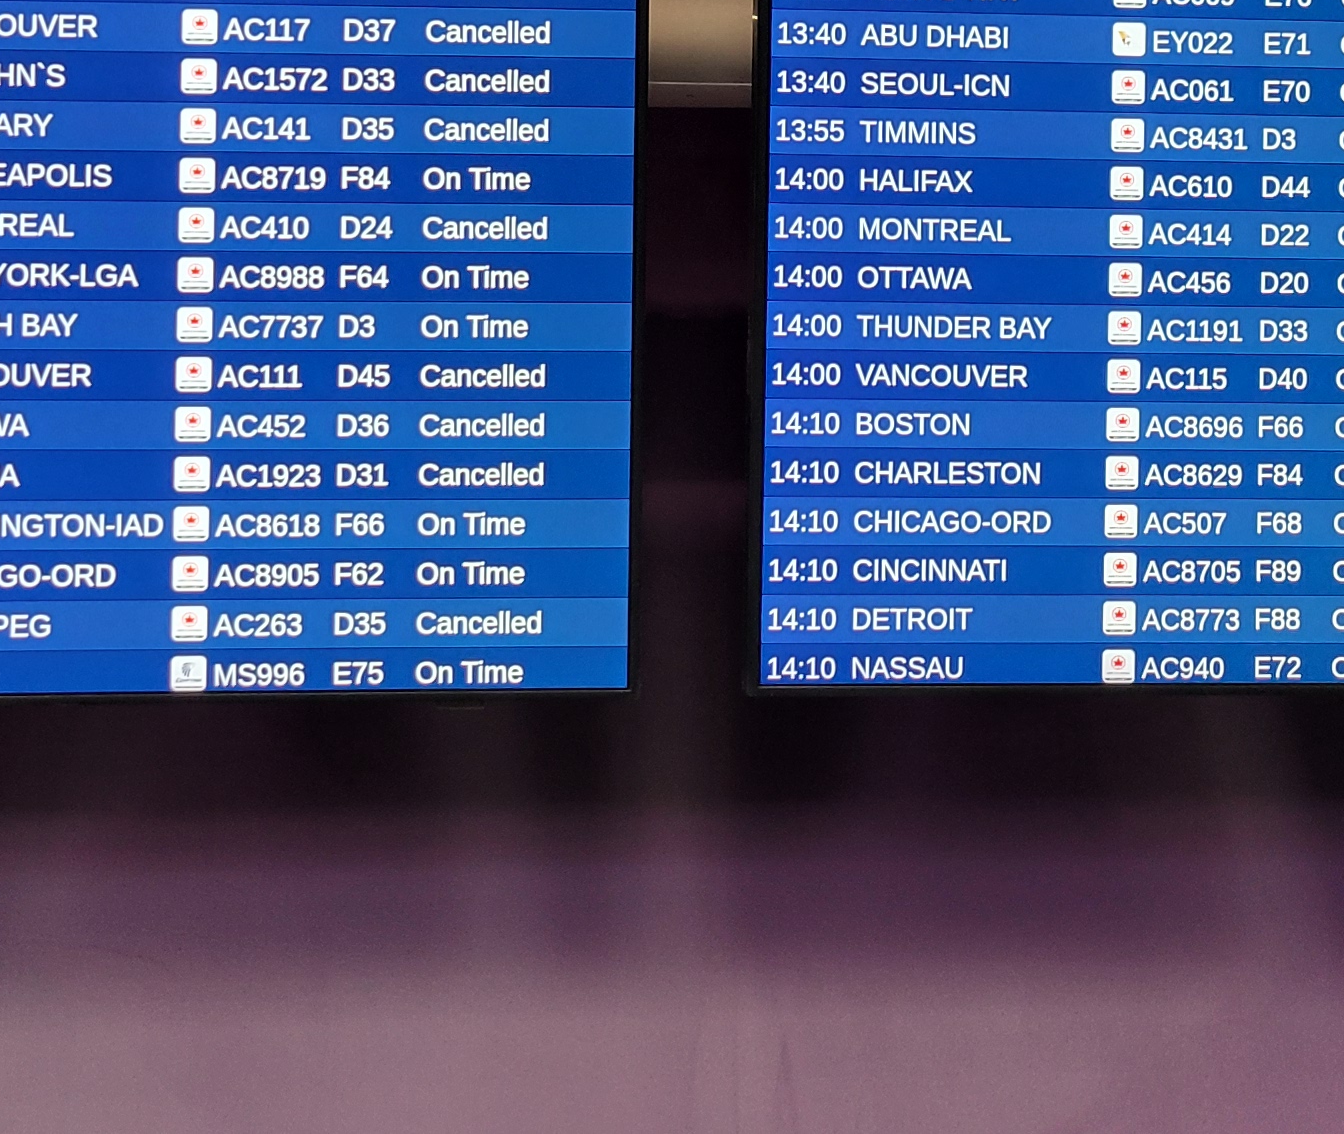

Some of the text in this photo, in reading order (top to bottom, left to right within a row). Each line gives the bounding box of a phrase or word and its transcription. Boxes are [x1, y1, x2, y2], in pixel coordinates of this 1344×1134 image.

[223, 67, 328, 91] AC1572
[343, 68, 395, 91] D33
[425, 69, 549, 93] Cancelled
[777, 71, 845, 93] 13:40
[861, 72, 1009, 96] SEOUL-ICN
[1151, 79, 1233, 101] AC061
[1264, 80, 1310, 102] E70
[774, 265, 842, 288] 14:00
[858, 266, 972, 290] OTTAWA
[1148, 271, 1230, 293] AC456
[1261, 272, 1308, 293] D20
[217, 415, 306, 438] AC452
[337, 414, 389, 437] D36
[419, 413, 544, 437] Cancelled
[214, 663, 304, 687] MS996
[333, 662, 384, 685] E75
[415, 661, 453, 684] On
[461, 660, 523, 684] Time
[768, 657, 835, 680] 14:10
[852, 657, 963, 679] NASSAU
[1141, 657, 1224, 679] AC940
[1255, 657, 1301, 679] E72
